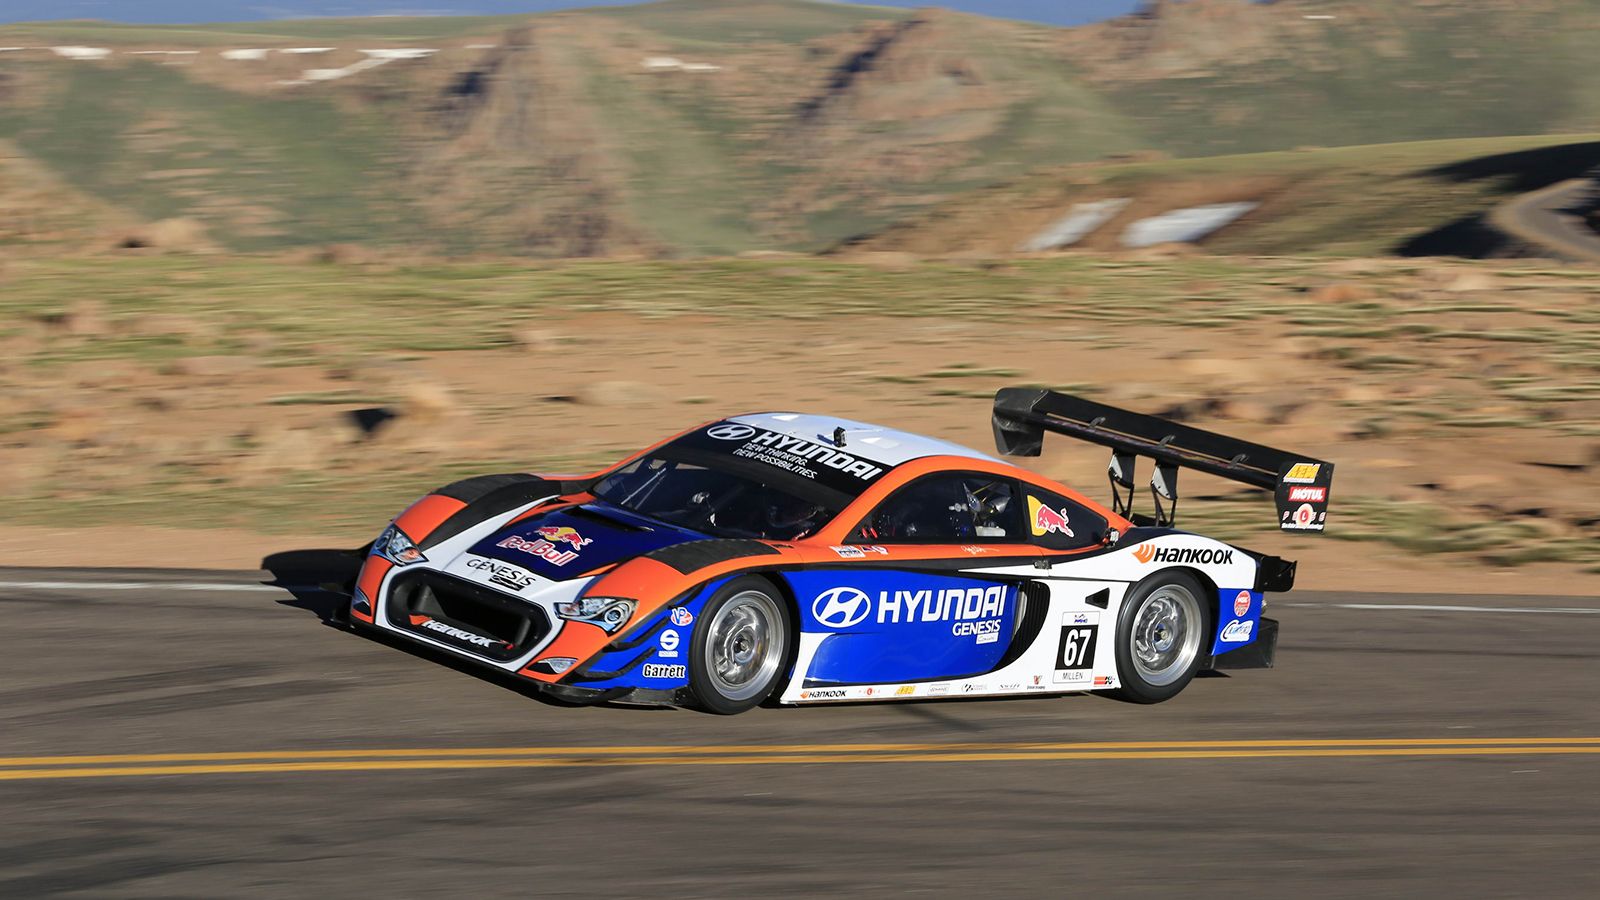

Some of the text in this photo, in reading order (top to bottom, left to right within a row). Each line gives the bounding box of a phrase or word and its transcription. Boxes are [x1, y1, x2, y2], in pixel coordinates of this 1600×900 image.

[751, 430, 883, 481] HYUNDAI
[1290, 487, 1323, 500] MOTUL
[466, 558, 536, 587] GENESIS
[876, 585, 1008, 624] HYUNDAI
[952, 619, 1002, 637] GENESIS
[1063, 628, 1092, 667] 67
[644, 664, 685, 677] Garrett
[1062, 672, 1083, 680] MILLEN
